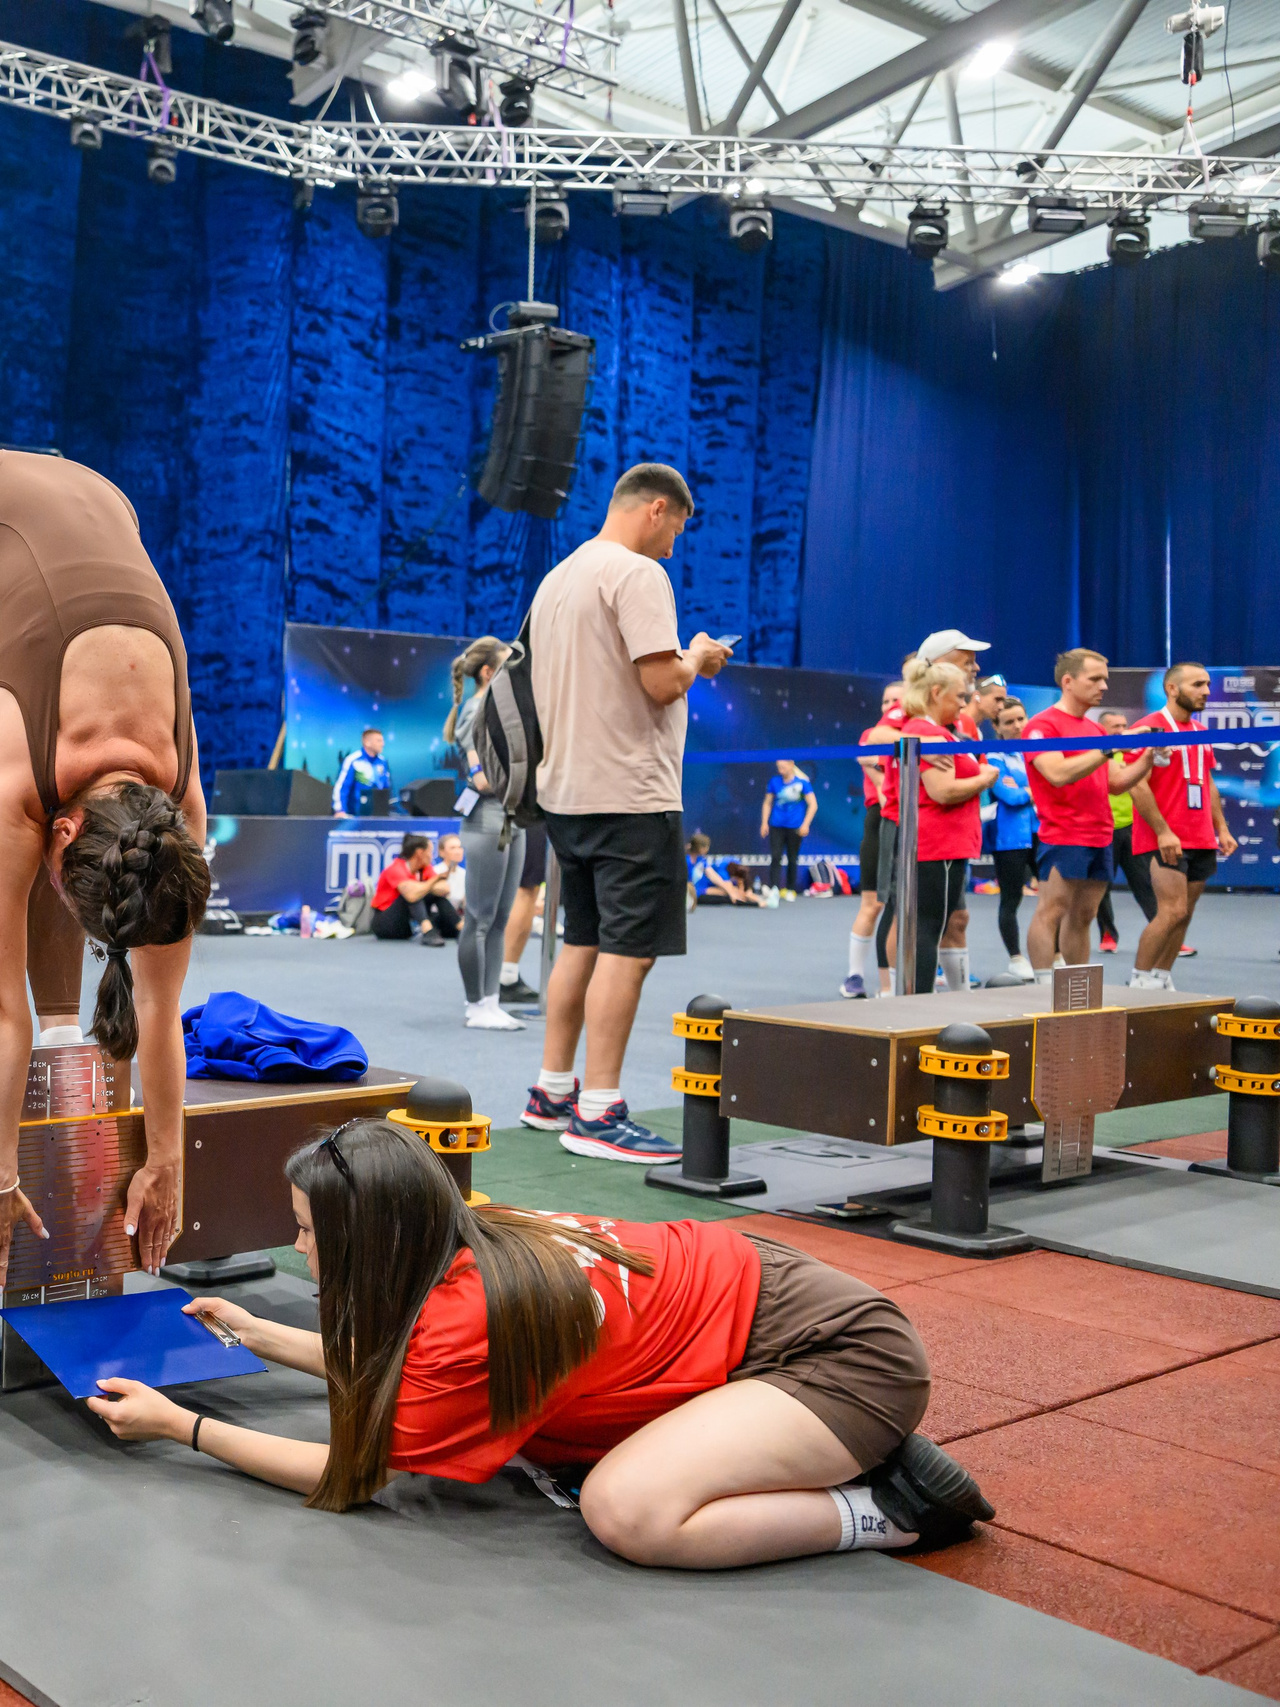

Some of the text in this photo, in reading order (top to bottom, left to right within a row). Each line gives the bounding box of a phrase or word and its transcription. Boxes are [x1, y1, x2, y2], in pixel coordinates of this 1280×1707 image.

[1225, 1021, 1267, 1035] ГТО
[925, 1056, 969, 1072] ГТО
[1222, 1076, 1265, 1090] ГТО
[923, 1117, 968, 1134] ГТО
